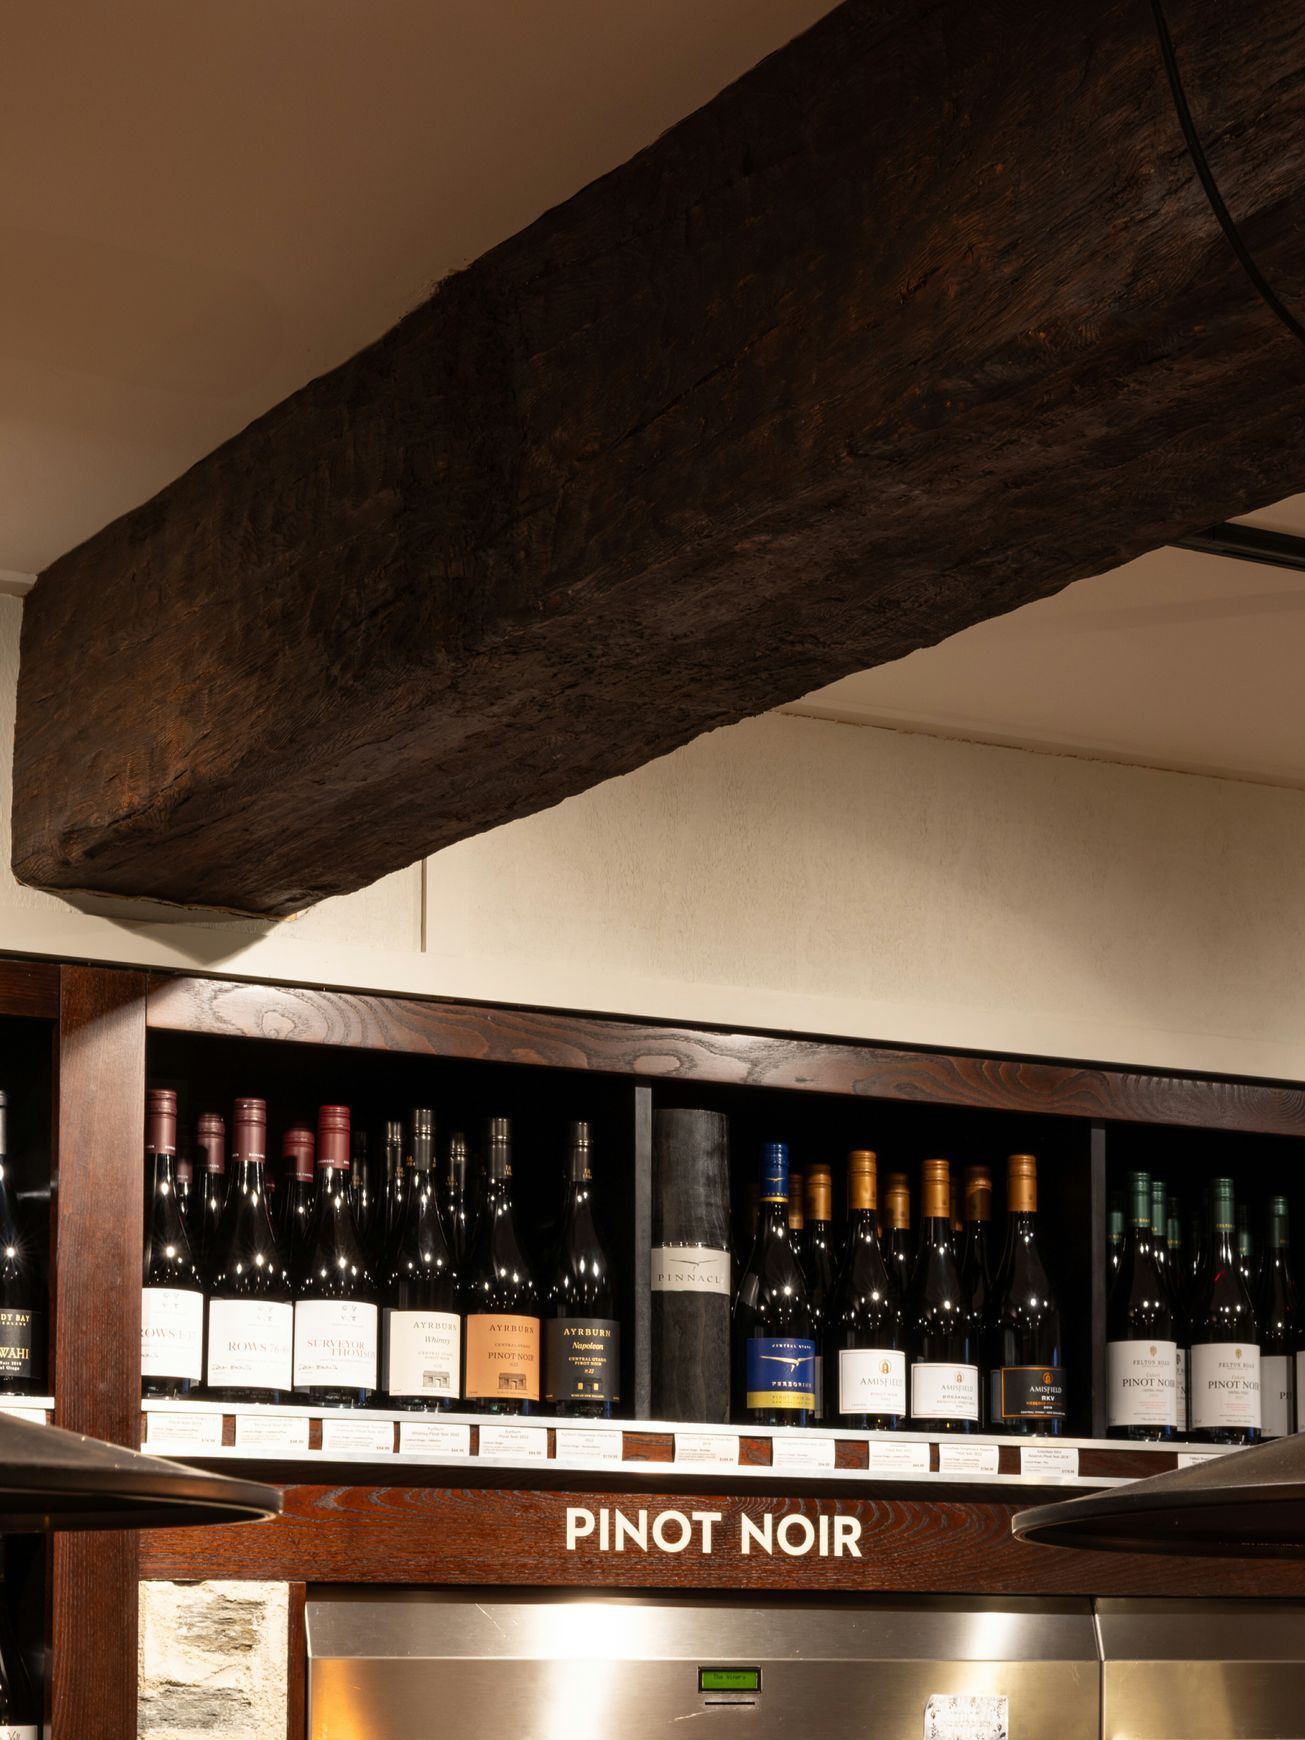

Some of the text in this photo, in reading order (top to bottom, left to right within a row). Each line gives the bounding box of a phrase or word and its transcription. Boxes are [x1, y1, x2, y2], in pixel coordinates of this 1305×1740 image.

[658, 1273, 721, 1284] PINNACL
[16, 1314, 30, 1322] BAY
[489, 1324, 535, 1334] AYRBURN
[563, 1328, 612, 1337] AYRBURN
[227, 1341, 267, 1353] ROWS
[307, 1339, 365, 1350] SURVEYOR
[572, 1341, 604, 1351] Napoleon
[487, 1352, 534, 1362] PINOT NOIR
[1122, 1378, 1154, 1388] PINOT
[1208, 1380, 1240, 1390] PINOT
[940, 1384, 974, 1393] AMISFIELD
[1029, 1386, 1062, 1394] AMISFIELD
[566, 1508, 862, 1557] PINOT NOIR
